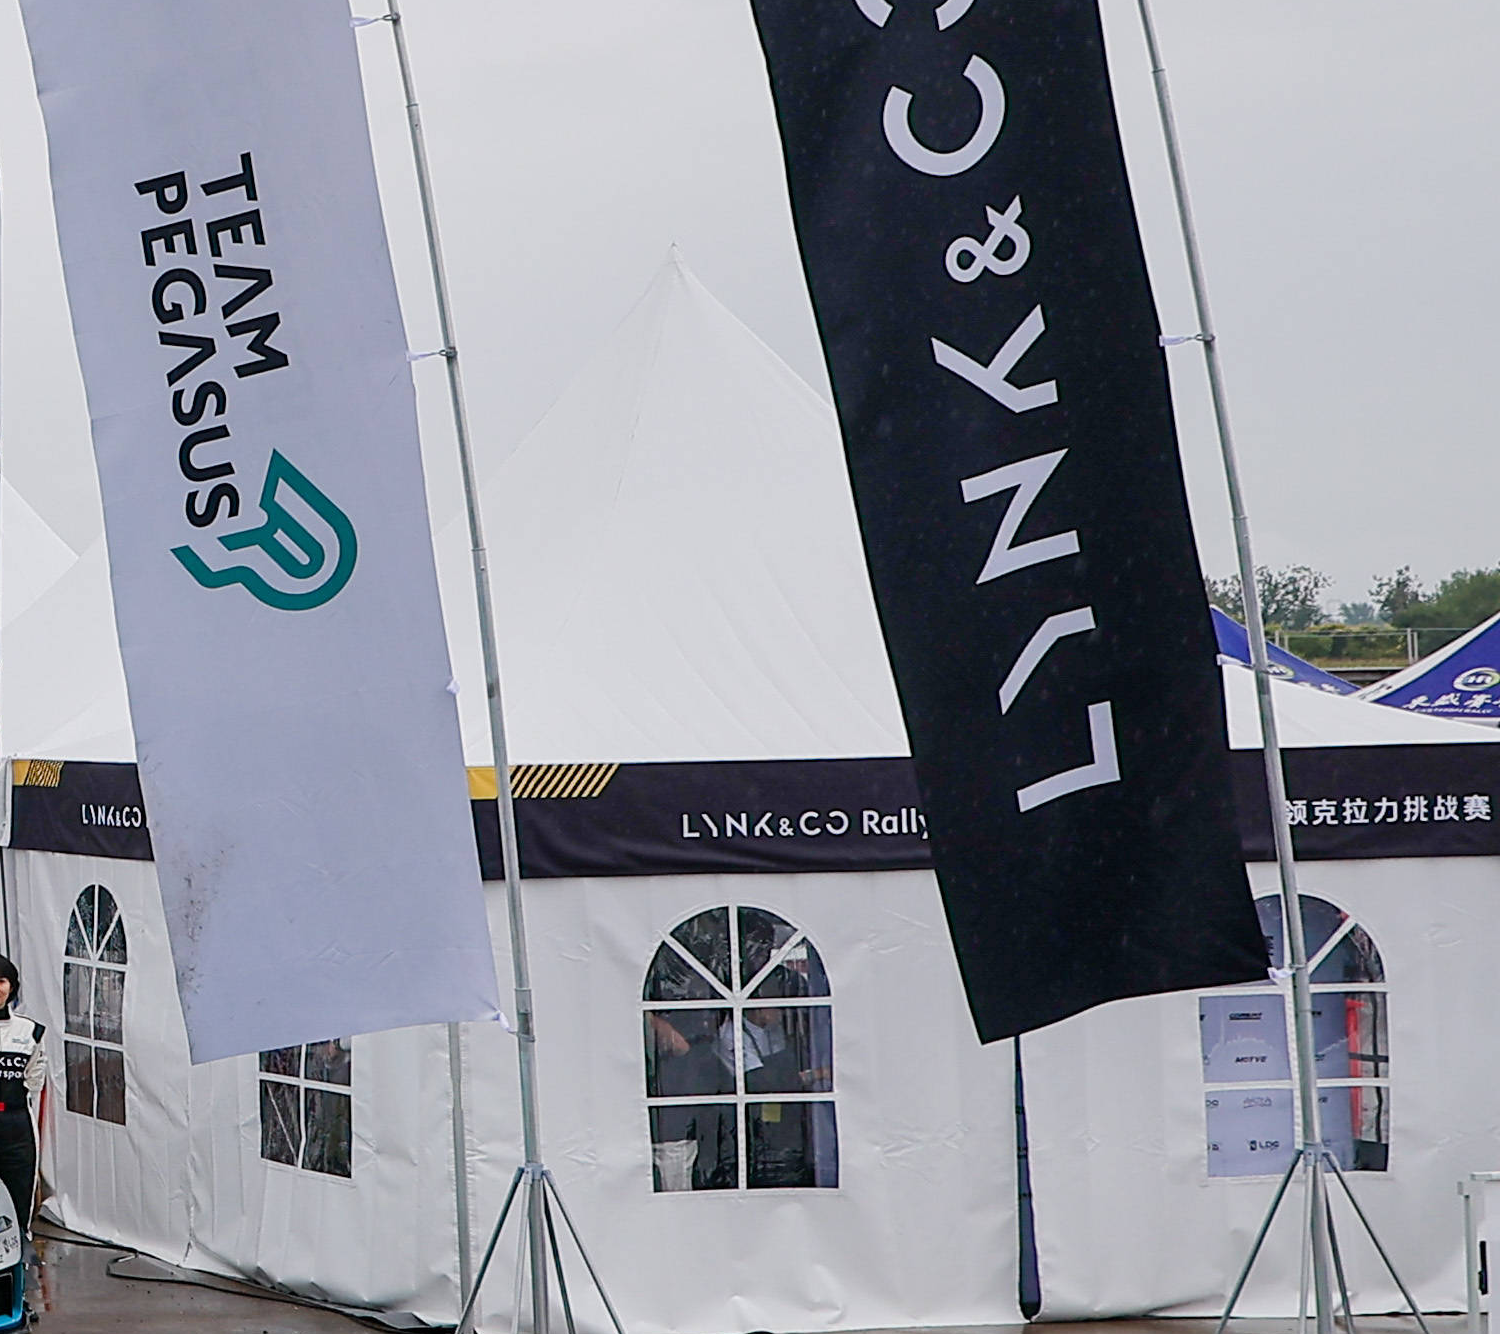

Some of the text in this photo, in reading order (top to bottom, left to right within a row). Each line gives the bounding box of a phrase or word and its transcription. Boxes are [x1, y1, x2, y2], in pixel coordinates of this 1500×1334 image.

[134, 170, 240, 529] PEGASUS
[201, 152, 289, 378] TEAM
[682, 811, 850, 839] LYNK&CO
